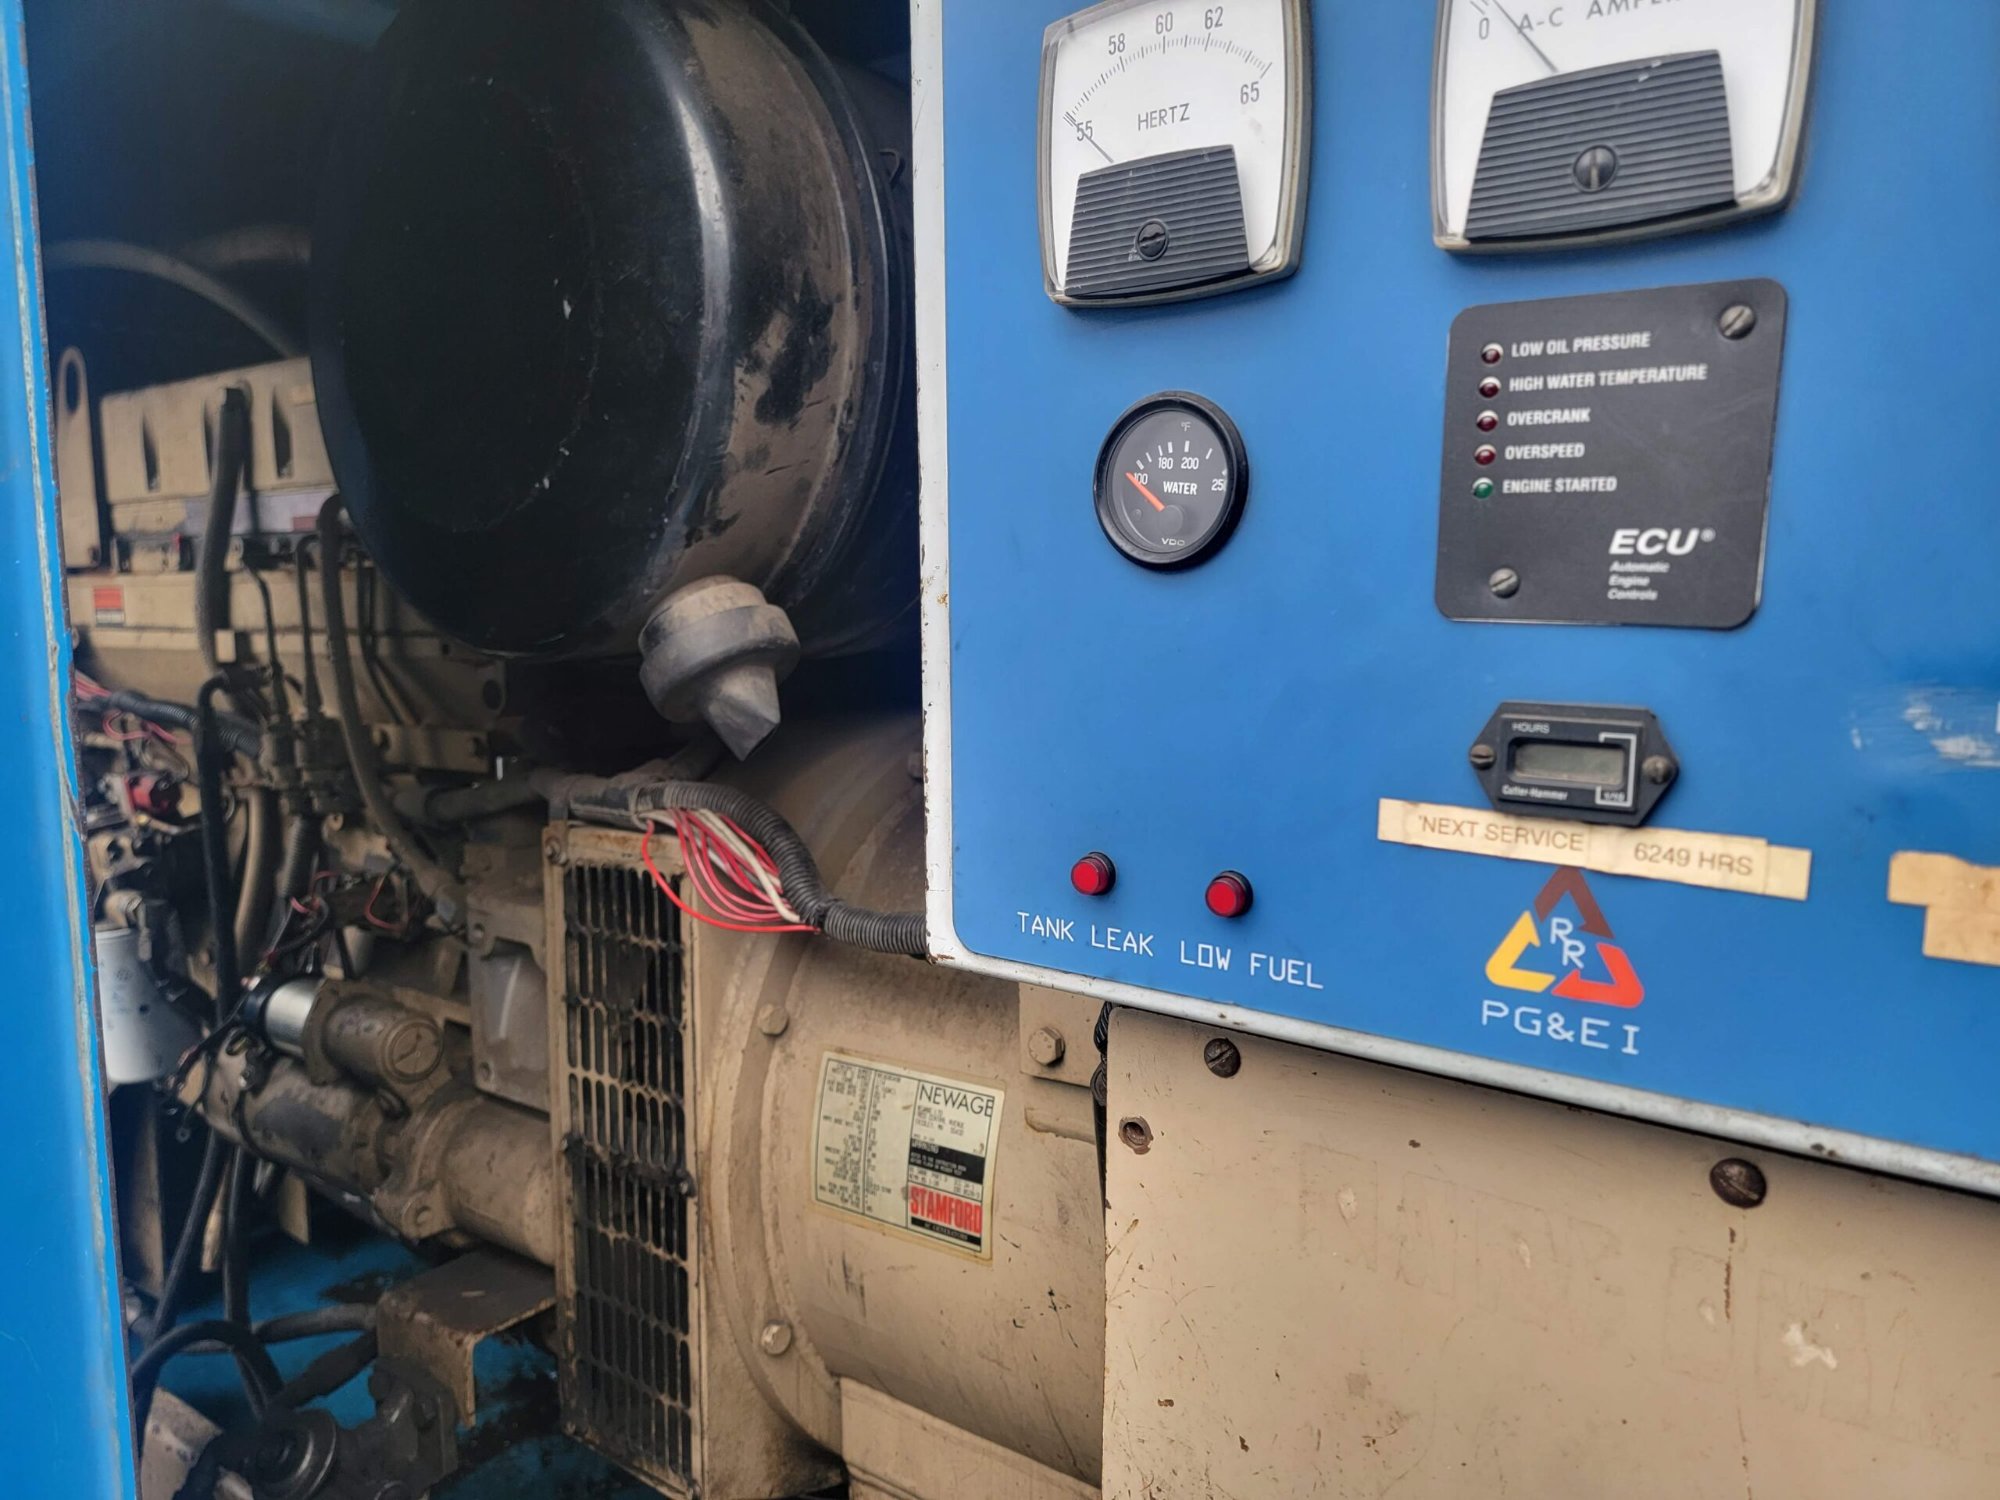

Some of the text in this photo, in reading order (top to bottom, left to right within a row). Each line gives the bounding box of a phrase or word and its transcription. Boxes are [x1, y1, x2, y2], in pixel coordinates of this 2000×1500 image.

[1155, 12, 1173, 34] 60
[1204, 6, 1223, 30] 62
[1478, 17, 1490, 40] 0
[1517, 7, 1564, 34] A-C
[1108, 33, 1126, 55] 58
[1240, 81, 1260, 105] 65
[1138, 103, 1191, 131] HERTZ
[1076, 120, 1094, 142] 55
[1511, 332, 1651, 357] LOW OIL PRESSURE
[1509, 364, 1708, 392] HIGH WATER TEMPERATURE
[1506, 408, 1591, 426] OVERCRANK
[1505, 442, 1585, 460] OVERSPEED
[1158, 457, 1199, 470] 180 200
[1163, 481, 1198, 495] WATER
[1502, 476, 1617, 494] ENGINE STARTED
[1609, 560, 1670, 573] Automatic
[1608, 574, 1651, 588] Engine
[1607, 588, 1658, 601] Controls
[1511, 722, 1550, 734] HOURS
[1484, 822, 1584, 853] SERVICE
[1633, 841, 1691, 868] 6249
[1698, 851, 1754, 877] HRS
[1017, 911, 1154, 957] TANK LEAK
[1180, 940, 1324, 990] LOW FUEL
[919, 1084, 994, 1118] NEWAGE
[910, 1185, 983, 1235] STAMFORD
